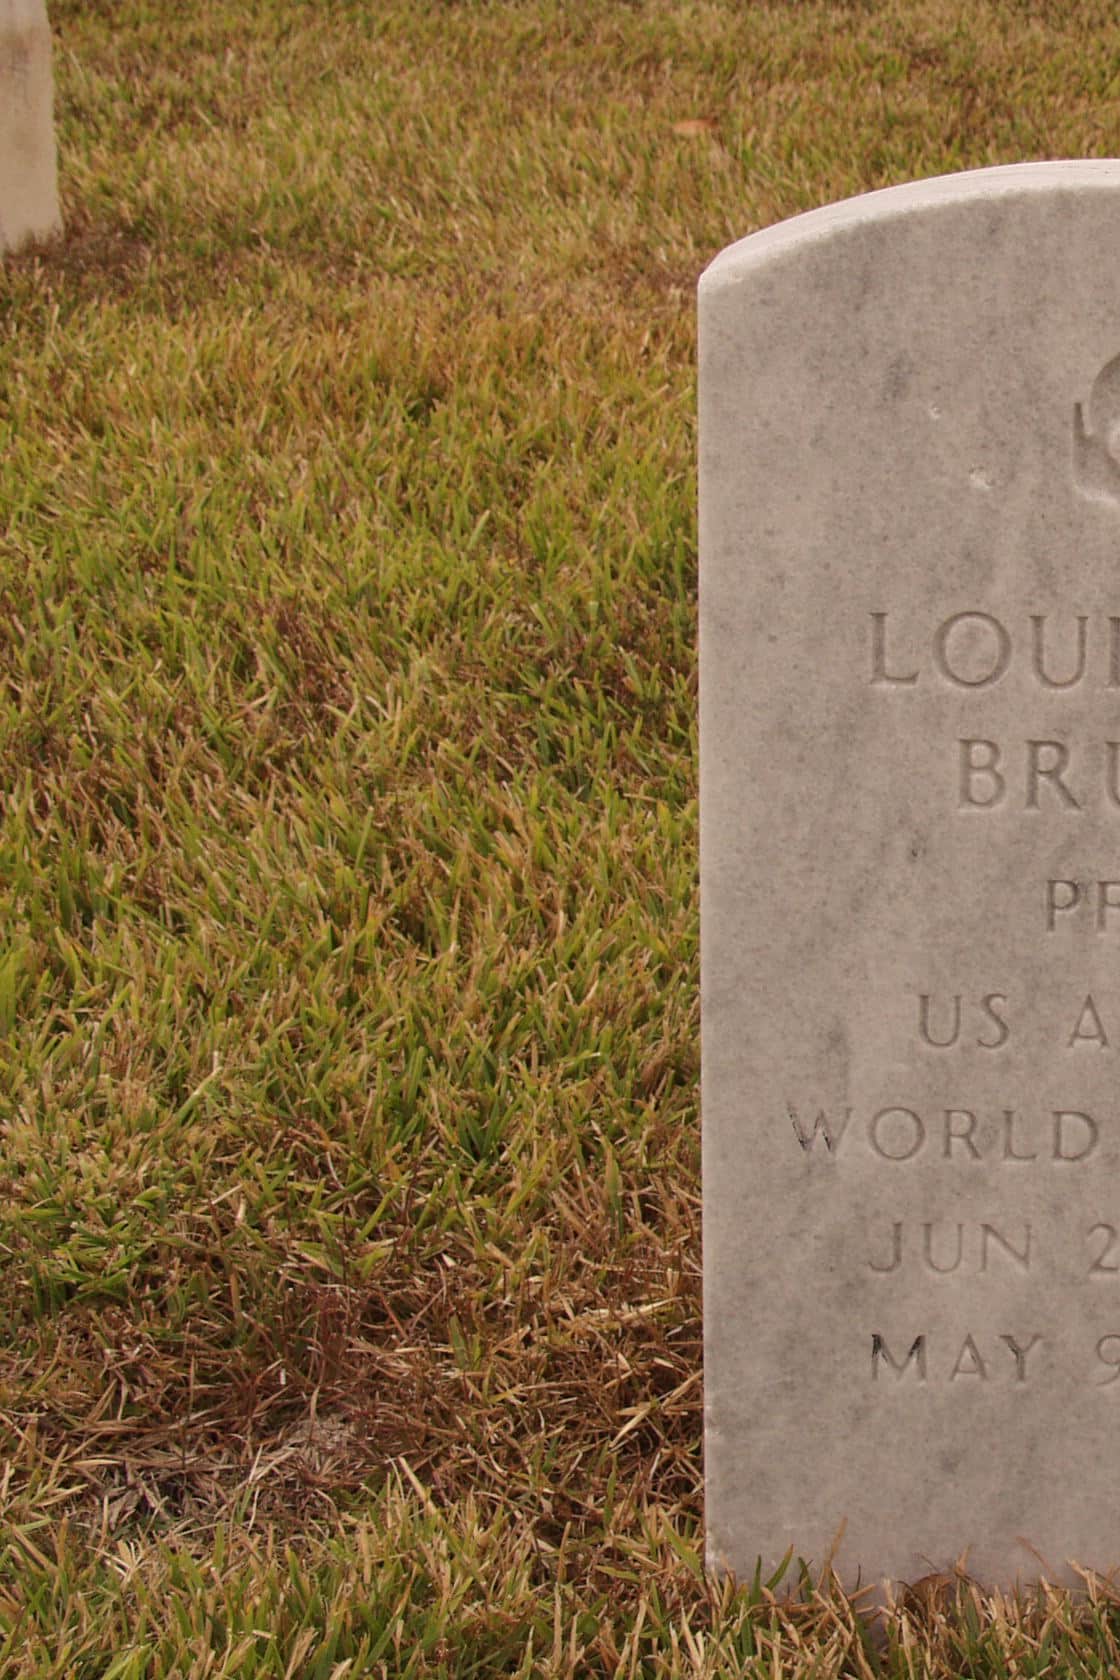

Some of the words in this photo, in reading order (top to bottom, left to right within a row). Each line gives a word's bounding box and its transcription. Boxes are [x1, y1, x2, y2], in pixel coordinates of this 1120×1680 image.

[917, 993, 1011, 1049] US
[788, 1106, 1098, 1161] WORLD
[869, 1221, 1032, 1273] JUN
[869, 1333, 1043, 1383] MAY
